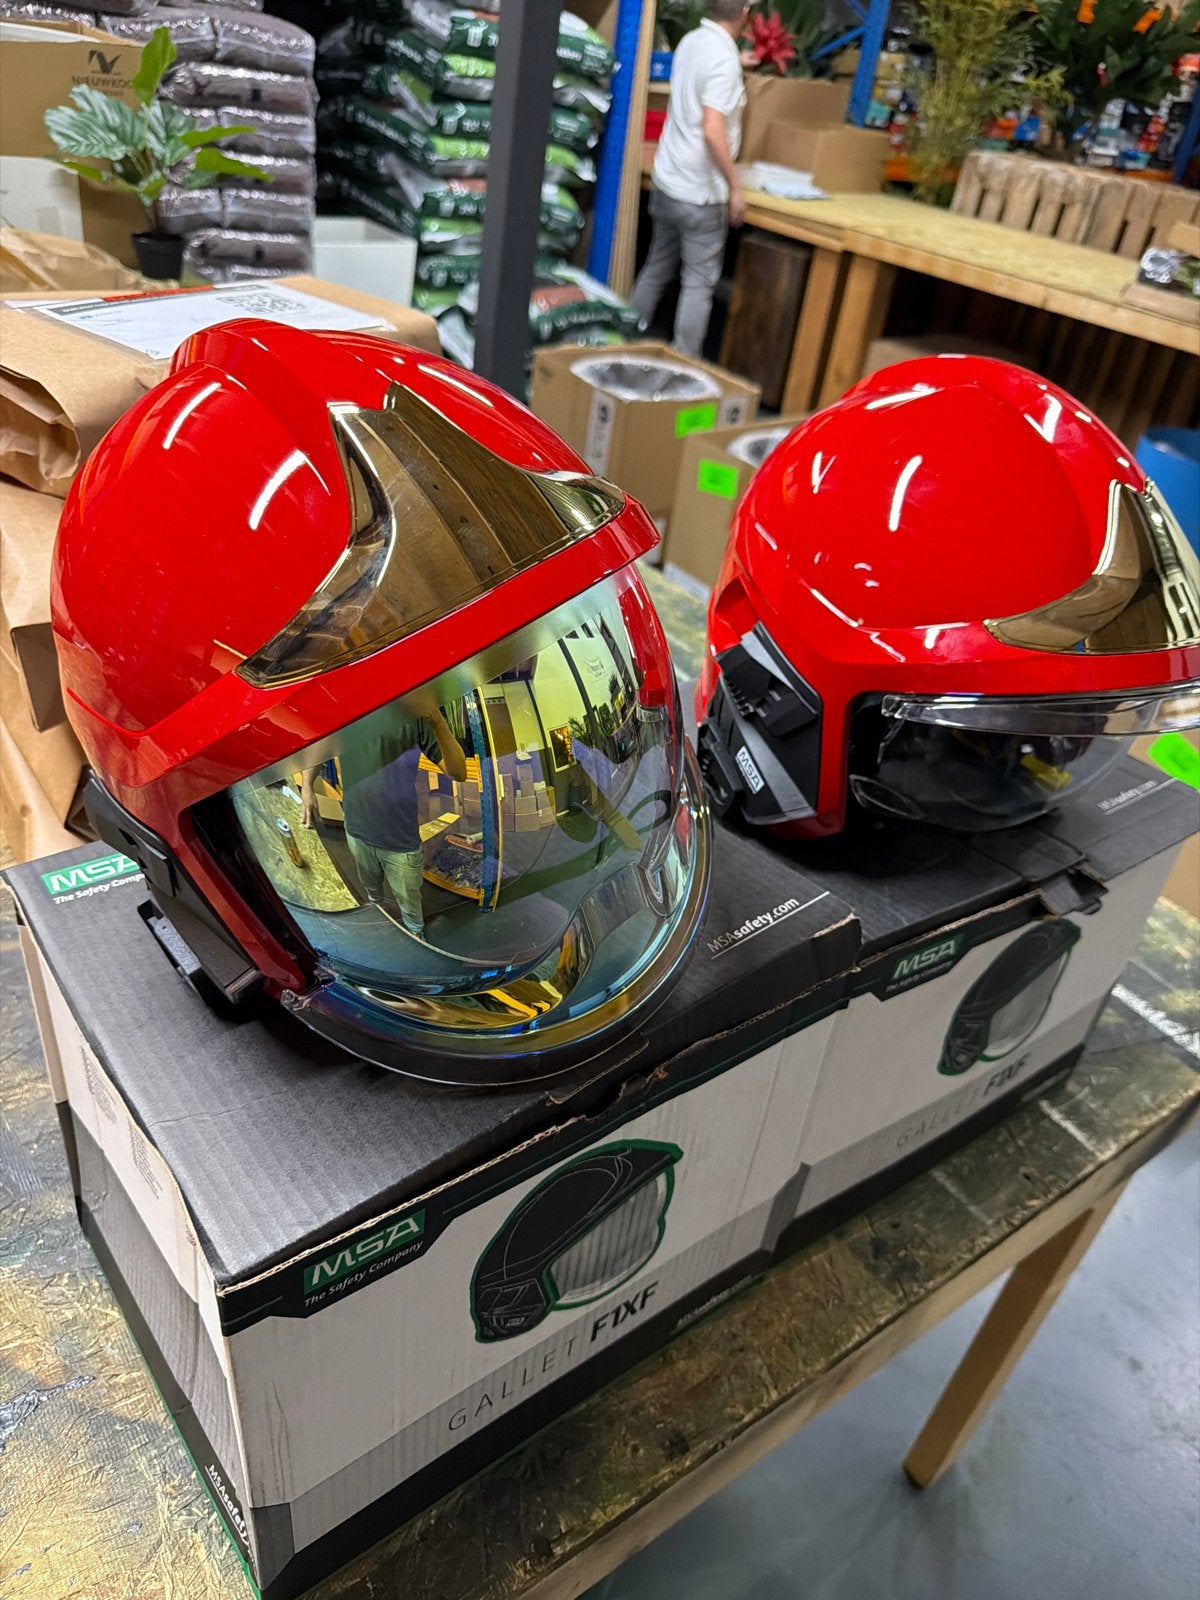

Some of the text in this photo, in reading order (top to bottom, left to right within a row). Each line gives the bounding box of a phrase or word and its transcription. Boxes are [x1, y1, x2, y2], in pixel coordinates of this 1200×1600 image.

[739, 751, 760, 789] MSA
[53, 893, 75, 904] The
[75, 882, 110, 898] Safety
[706, 898, 800, 953] MSAsafety.com
[893, 939, 956, 979] MSA
[304, 1240, 424, 1307] The Safety Company
[311, 1217, 420, 1286] MSA
[448, 1336, 578, 1431] GALLET
[590, 1281, 658, 1343] F1XF
